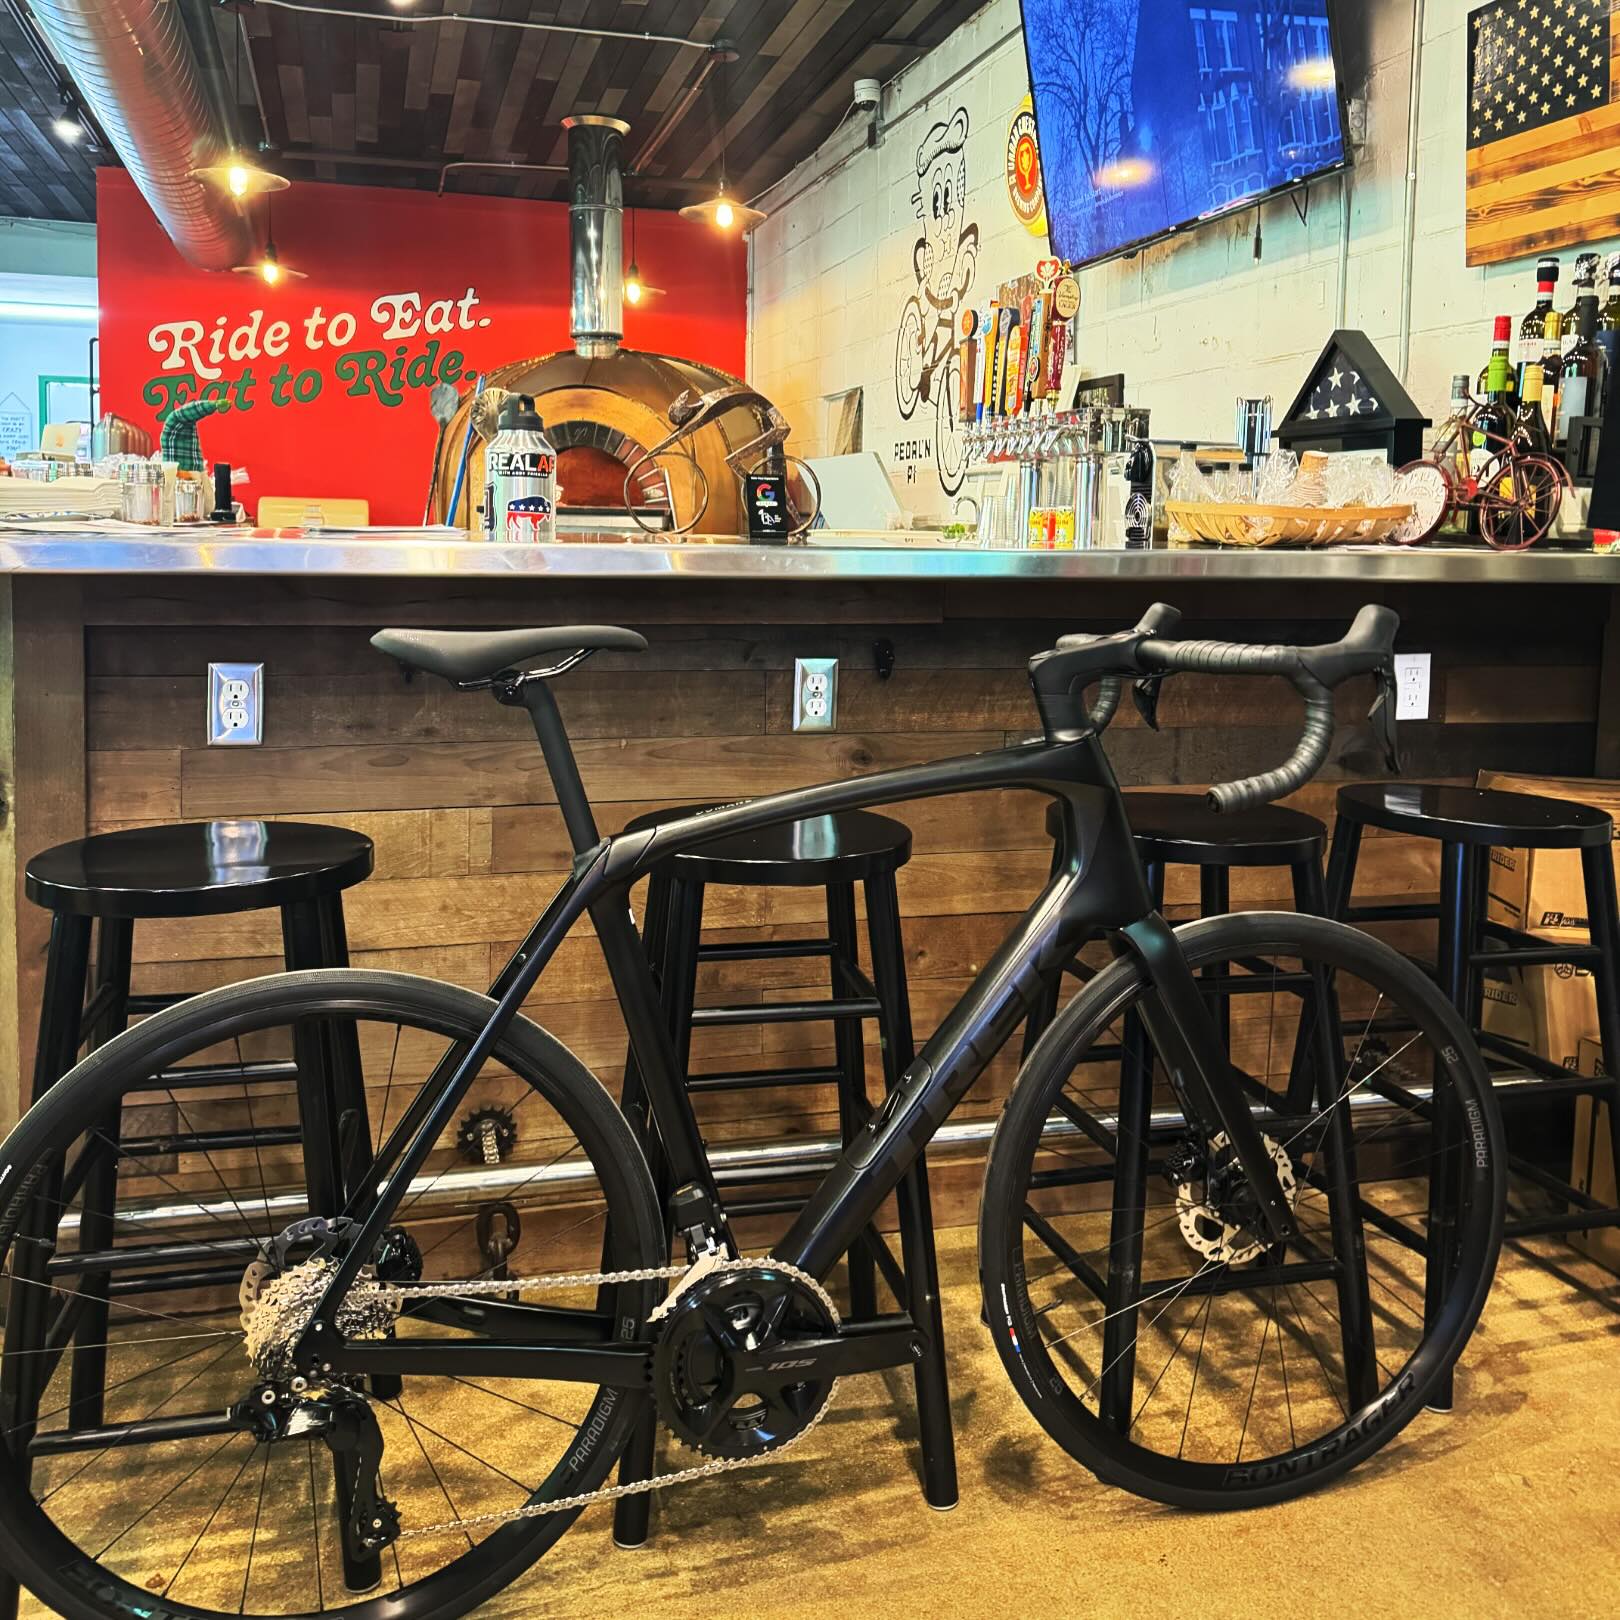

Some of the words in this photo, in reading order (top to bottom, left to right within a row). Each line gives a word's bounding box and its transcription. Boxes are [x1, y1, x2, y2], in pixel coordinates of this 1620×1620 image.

[148, 310, 291, 380] Ride
[303, 306, 357, 350] to
[370, 287, 493, 341] Eat.
[142, 367, 257, 422] Eat
[269, 363, 323, 408] to
[334, 340, 478, 408] Ride.
[894, 438, 931, 461] PEDAL'N
[1465, 1099, 1488, 1168] PARADIGM
[620, 1316, 635, 1340] 25
[767, 1358, 817, 1371] 105
[568, 1387, 619, 1472] PARADIGM
[1222, 1371, 1415, 1487] BONTRAGER
